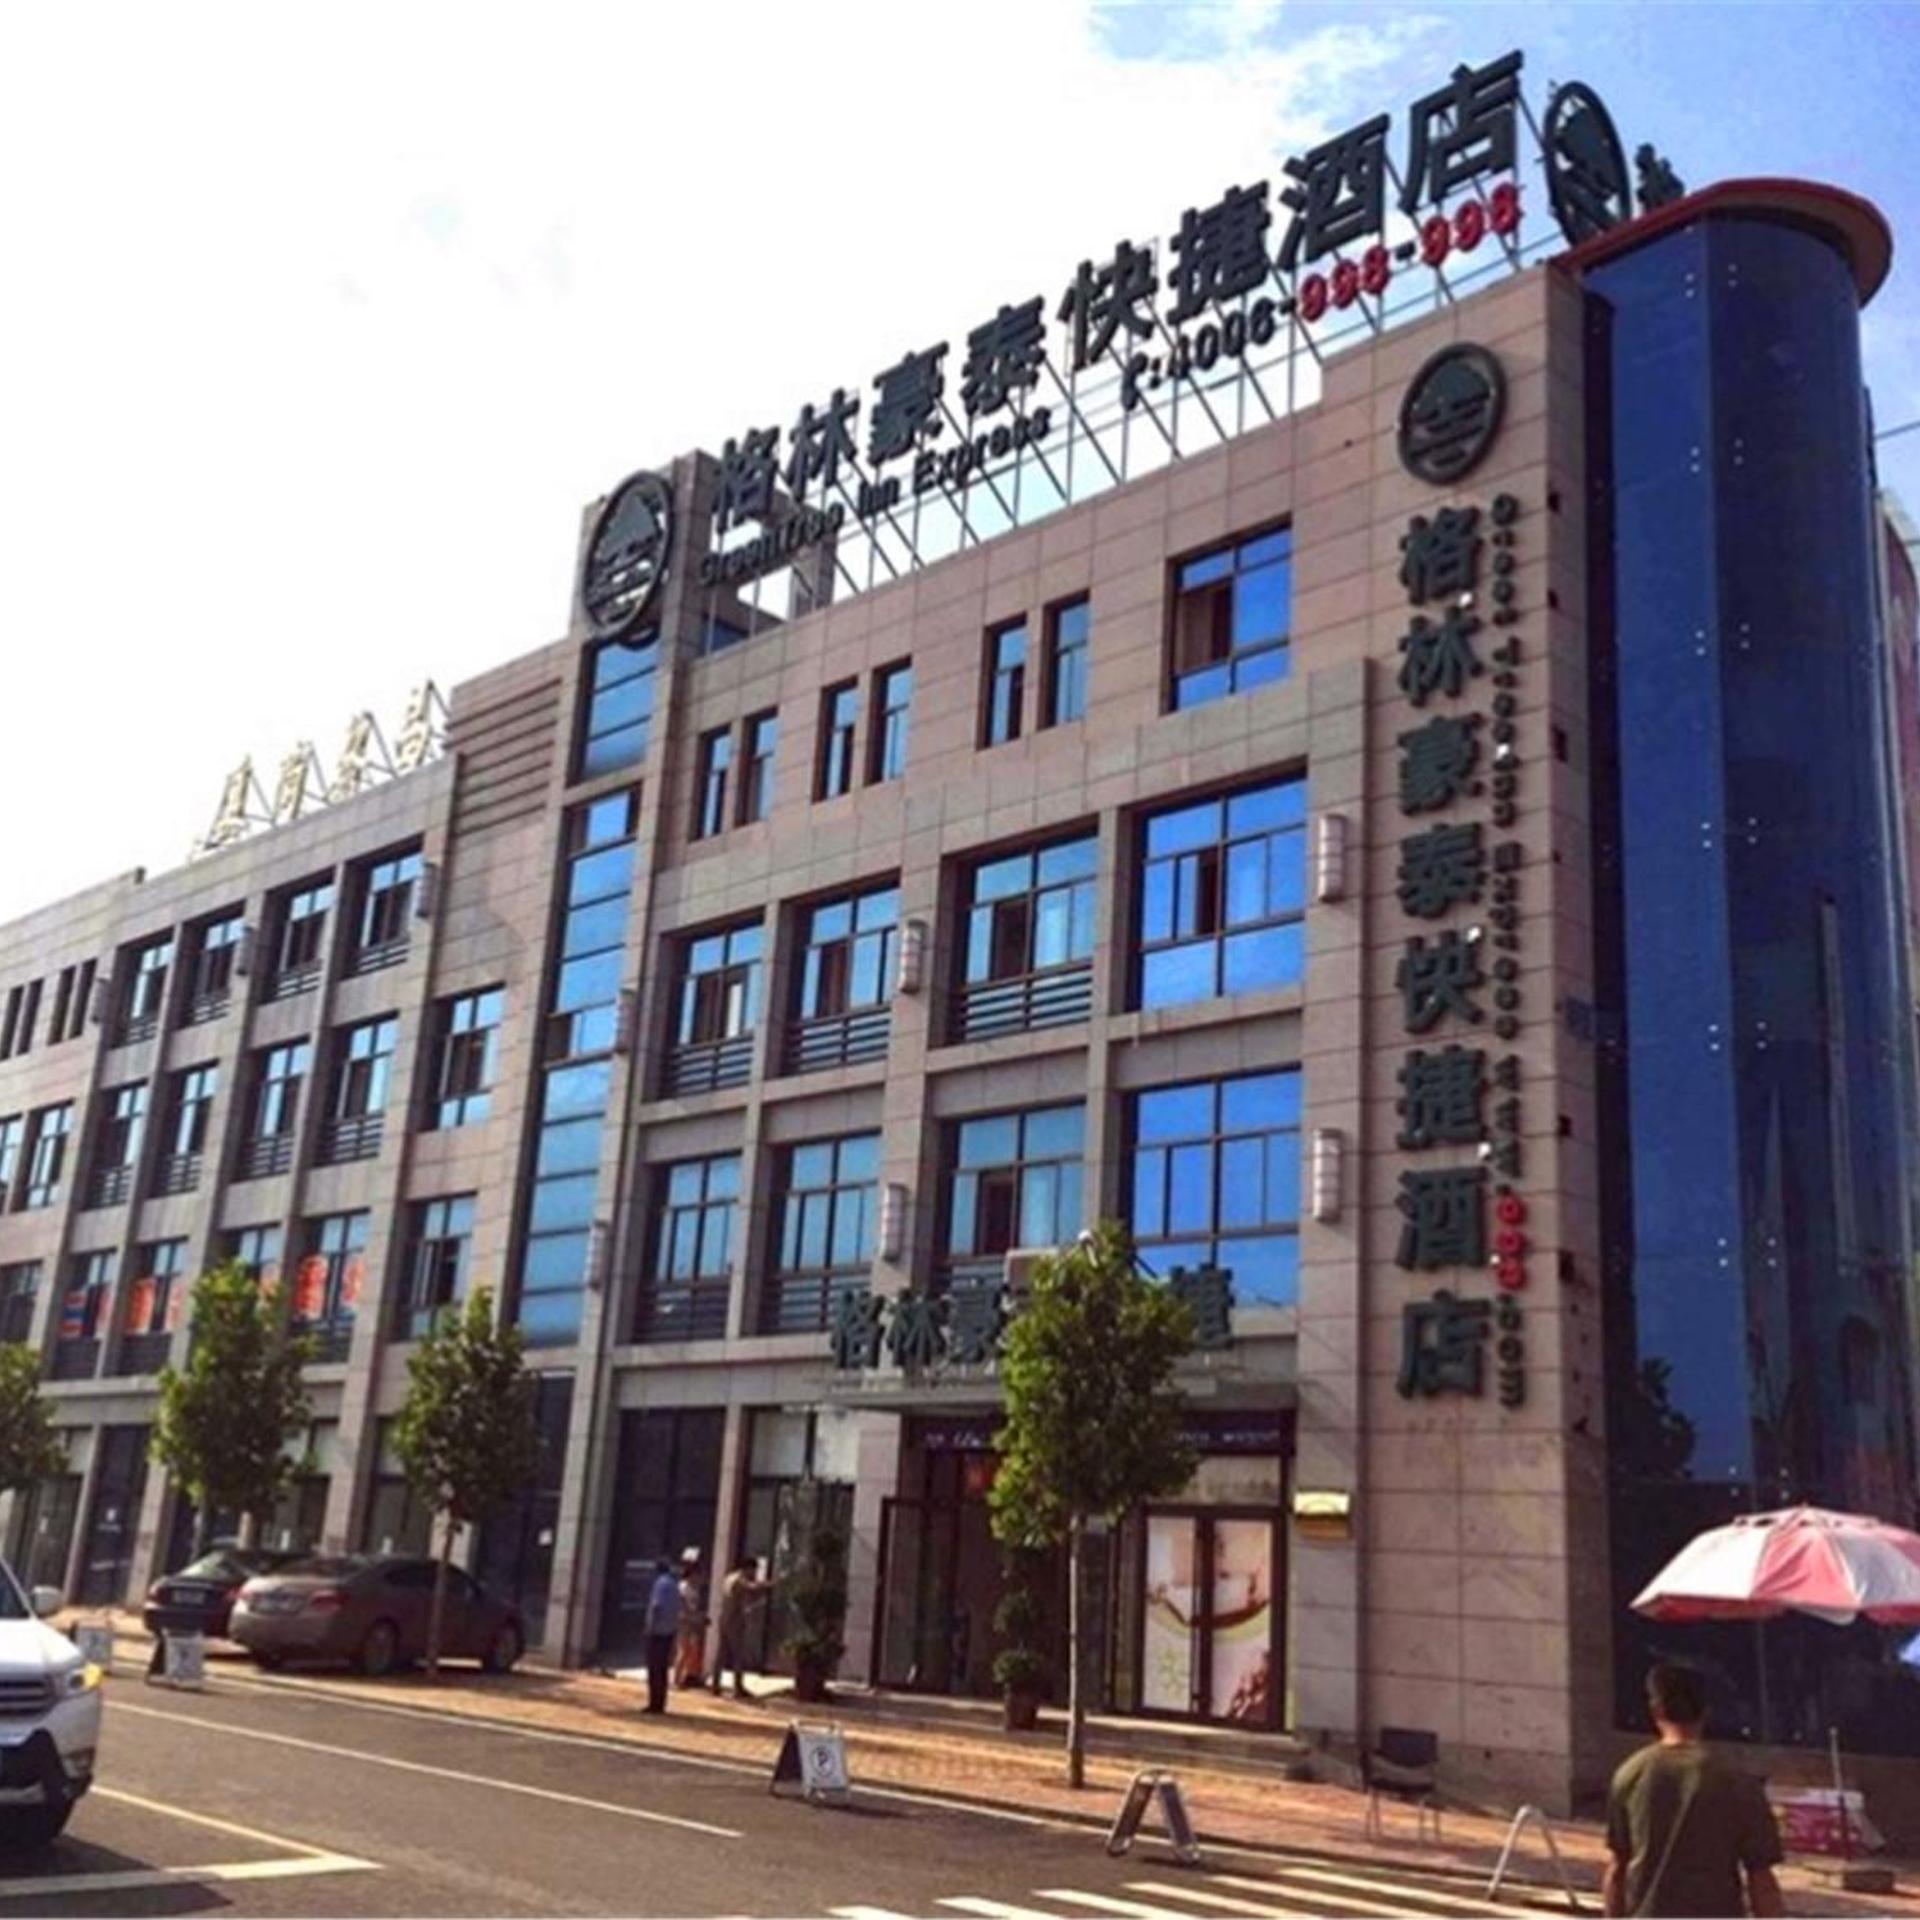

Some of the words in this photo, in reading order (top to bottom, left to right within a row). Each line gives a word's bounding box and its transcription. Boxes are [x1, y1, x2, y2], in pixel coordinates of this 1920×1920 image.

[710, 49, 1524, 536] 格林豪泰快捷酒店
[911, 405, 1052, 496] Express
[1396, 506, 1490, 1398] 格林豪泰快捷酒店
